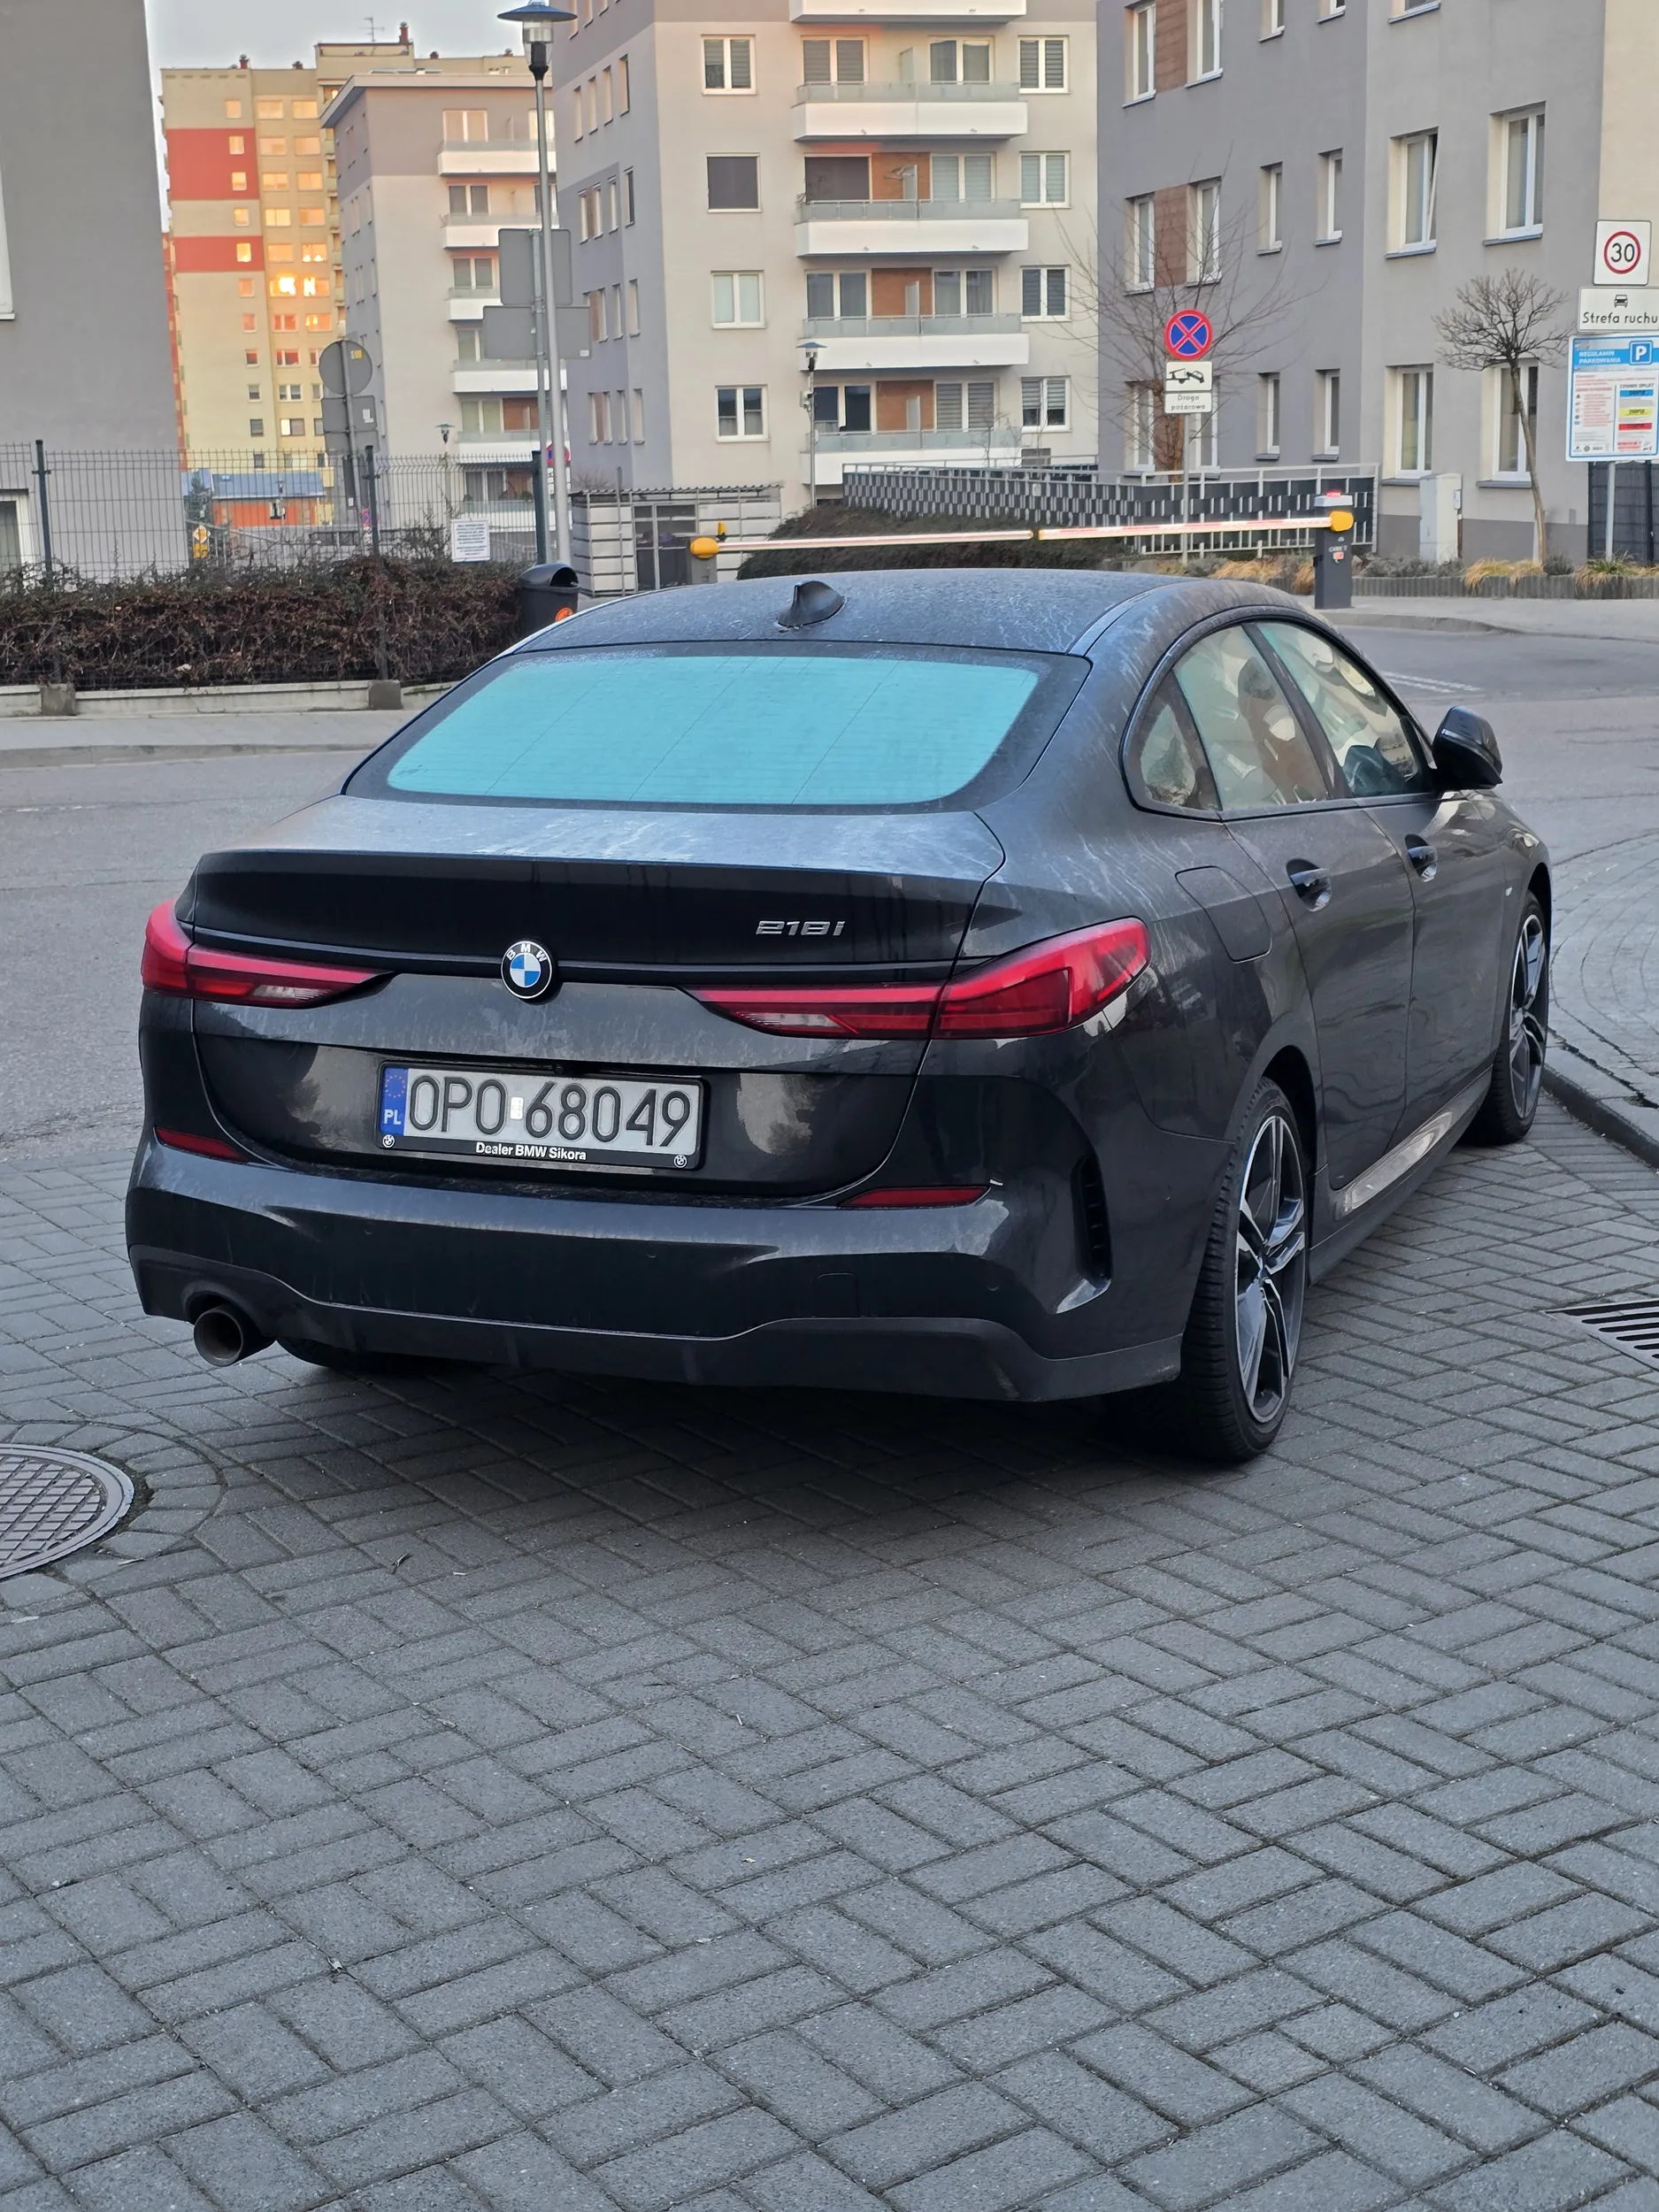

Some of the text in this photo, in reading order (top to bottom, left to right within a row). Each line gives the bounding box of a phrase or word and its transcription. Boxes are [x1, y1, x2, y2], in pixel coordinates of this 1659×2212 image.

[1610, 242, 1635, 263] 30
[1582, 311, 1658, 324] Strefa ruchu
[1635, 345, 1647, 361] P
[755, 920, 846, 936] 218i
[505, 943, 548, 963] BMW
[383, 1109, 402, 1125] PL
[409, 1074, 691, 1148] OPO 68049
[475, 1141, 587, 1161] Dealer BMW Sikora
